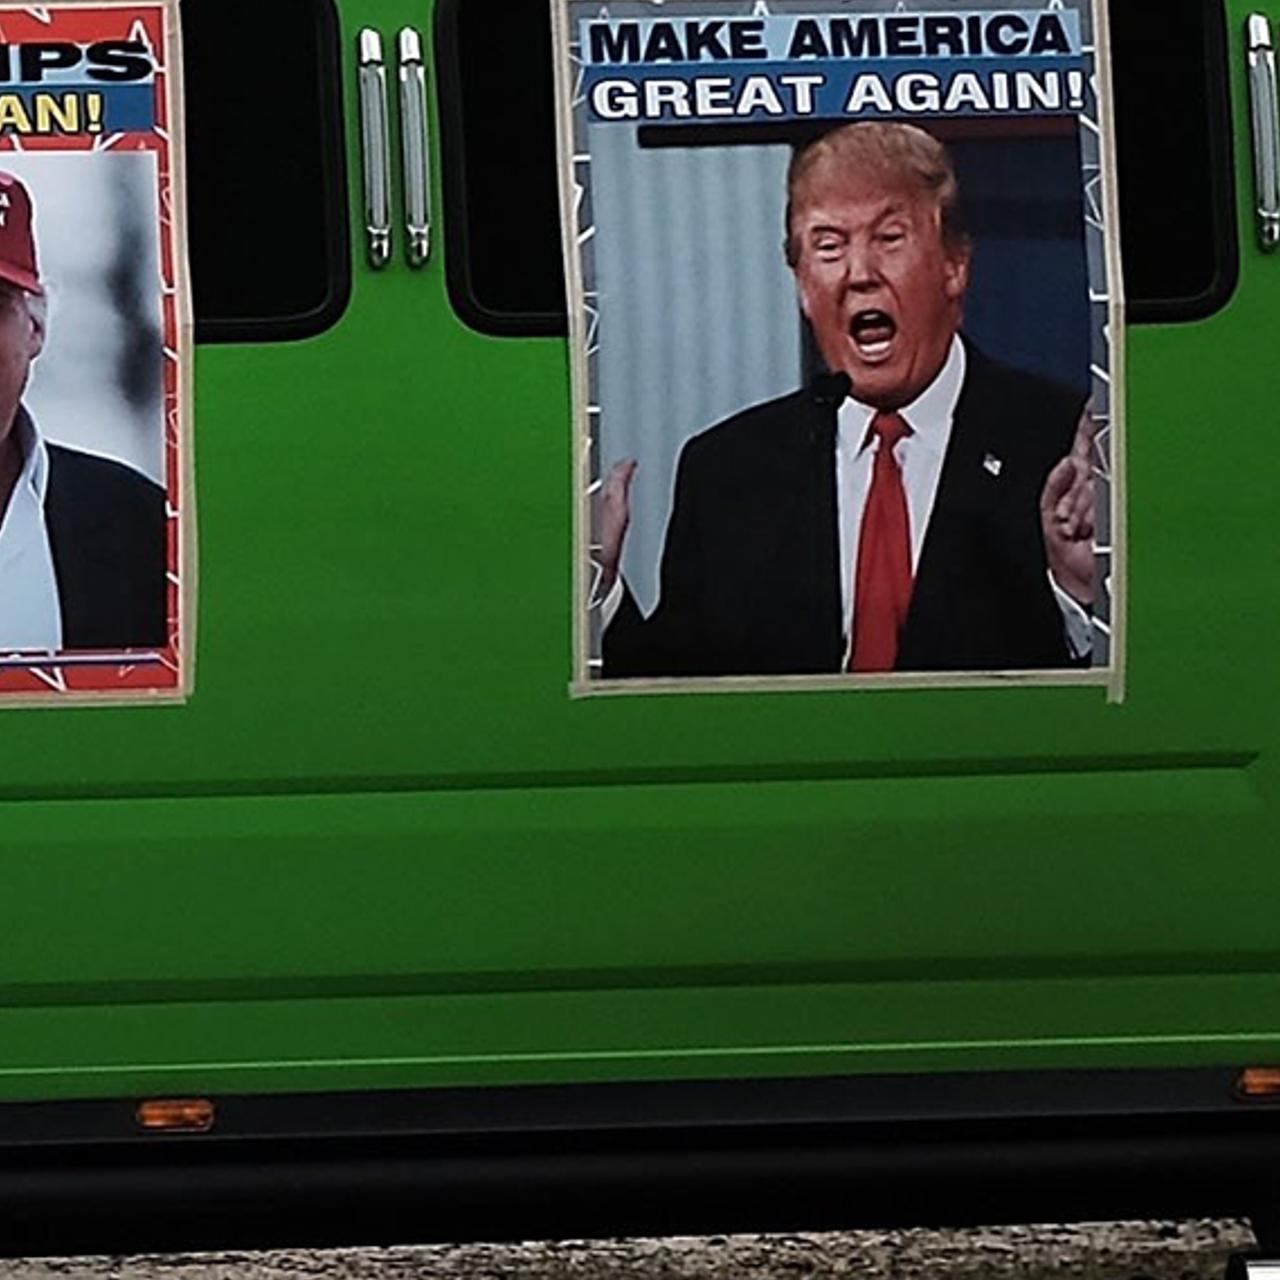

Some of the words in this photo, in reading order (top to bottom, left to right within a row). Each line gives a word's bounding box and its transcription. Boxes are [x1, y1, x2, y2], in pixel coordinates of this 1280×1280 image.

[589, 19, 768, 64] MAKE
[788, 13, 1072, 60] AMERICA
[591, 75, 824, 118] GREAT
[847, 71, 1083, 114] AGAIN!
